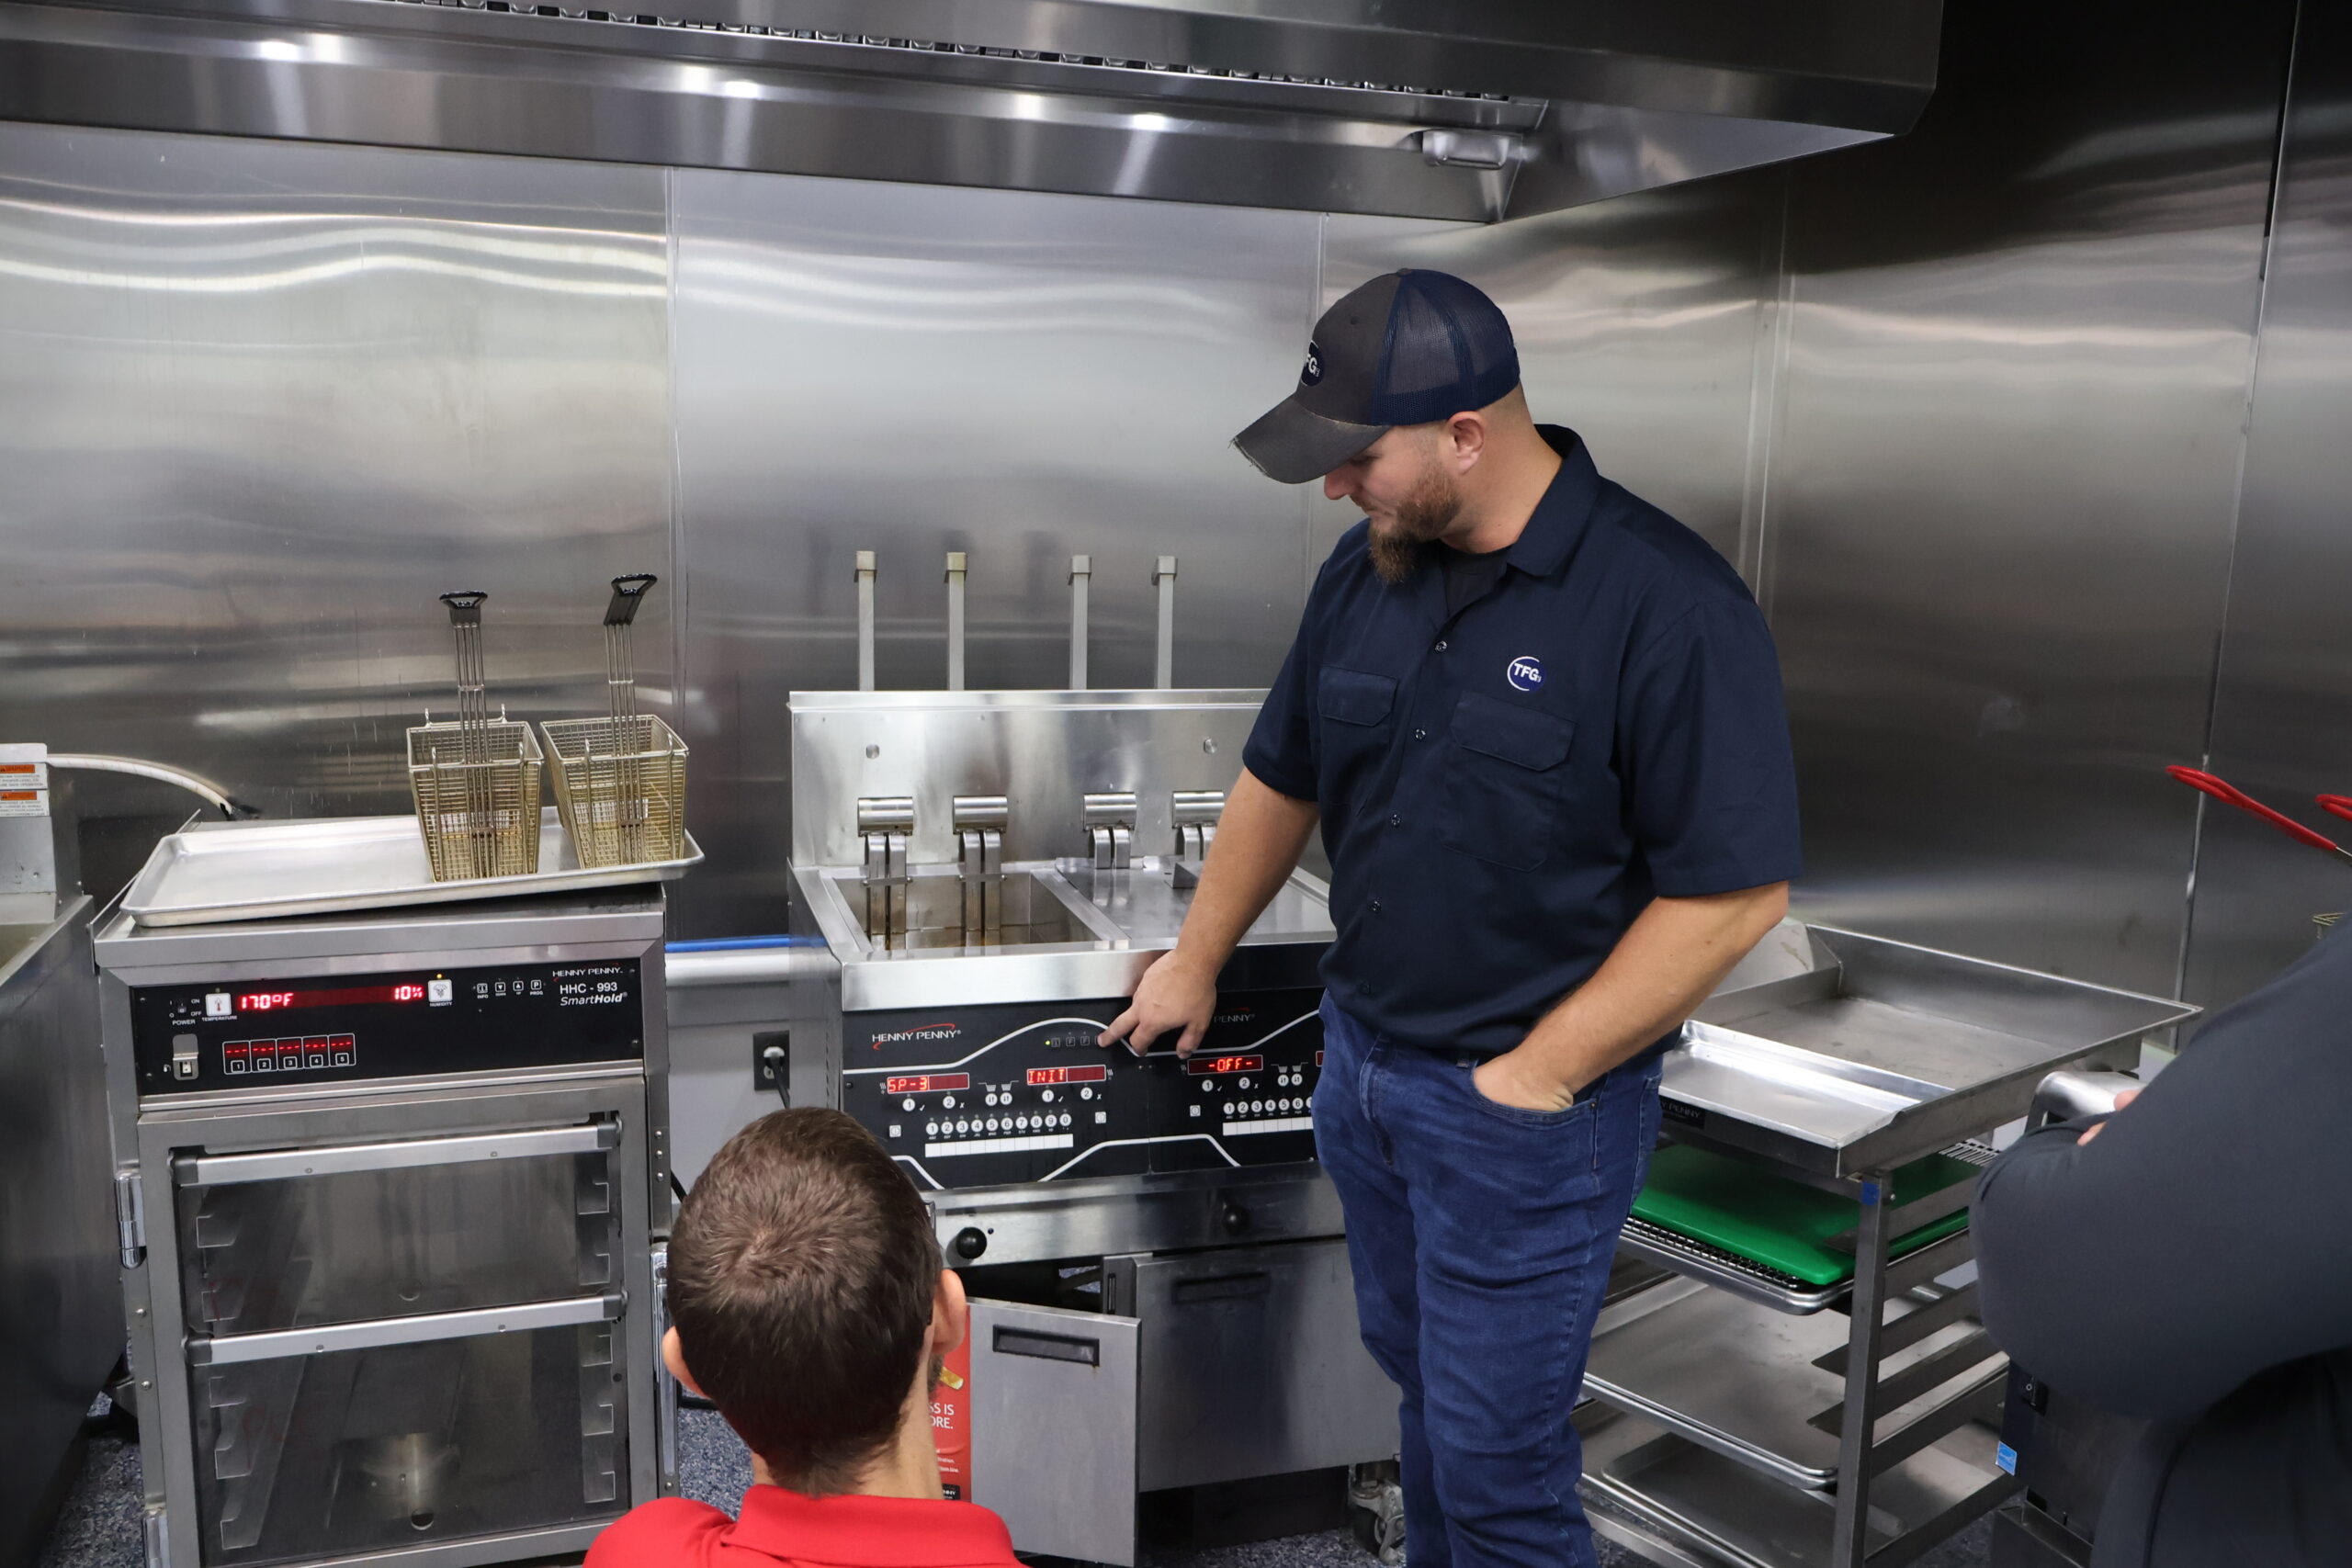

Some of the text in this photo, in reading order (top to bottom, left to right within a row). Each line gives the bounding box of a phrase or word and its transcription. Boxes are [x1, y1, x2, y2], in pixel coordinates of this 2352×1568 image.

[1514, 662, 1540, 682] TFG
[552, 969, 586, 977] HENNY
[560, 983, 587, 995] HHC
[597, 982, 617, 992] 993
[872, 1032, 913, 1042] HENNY
[1029, 1068, 1066, 1083] INIT
[888, 1077, 928, 1092] SP-3
[944, 1404, 955, 1416] IS
